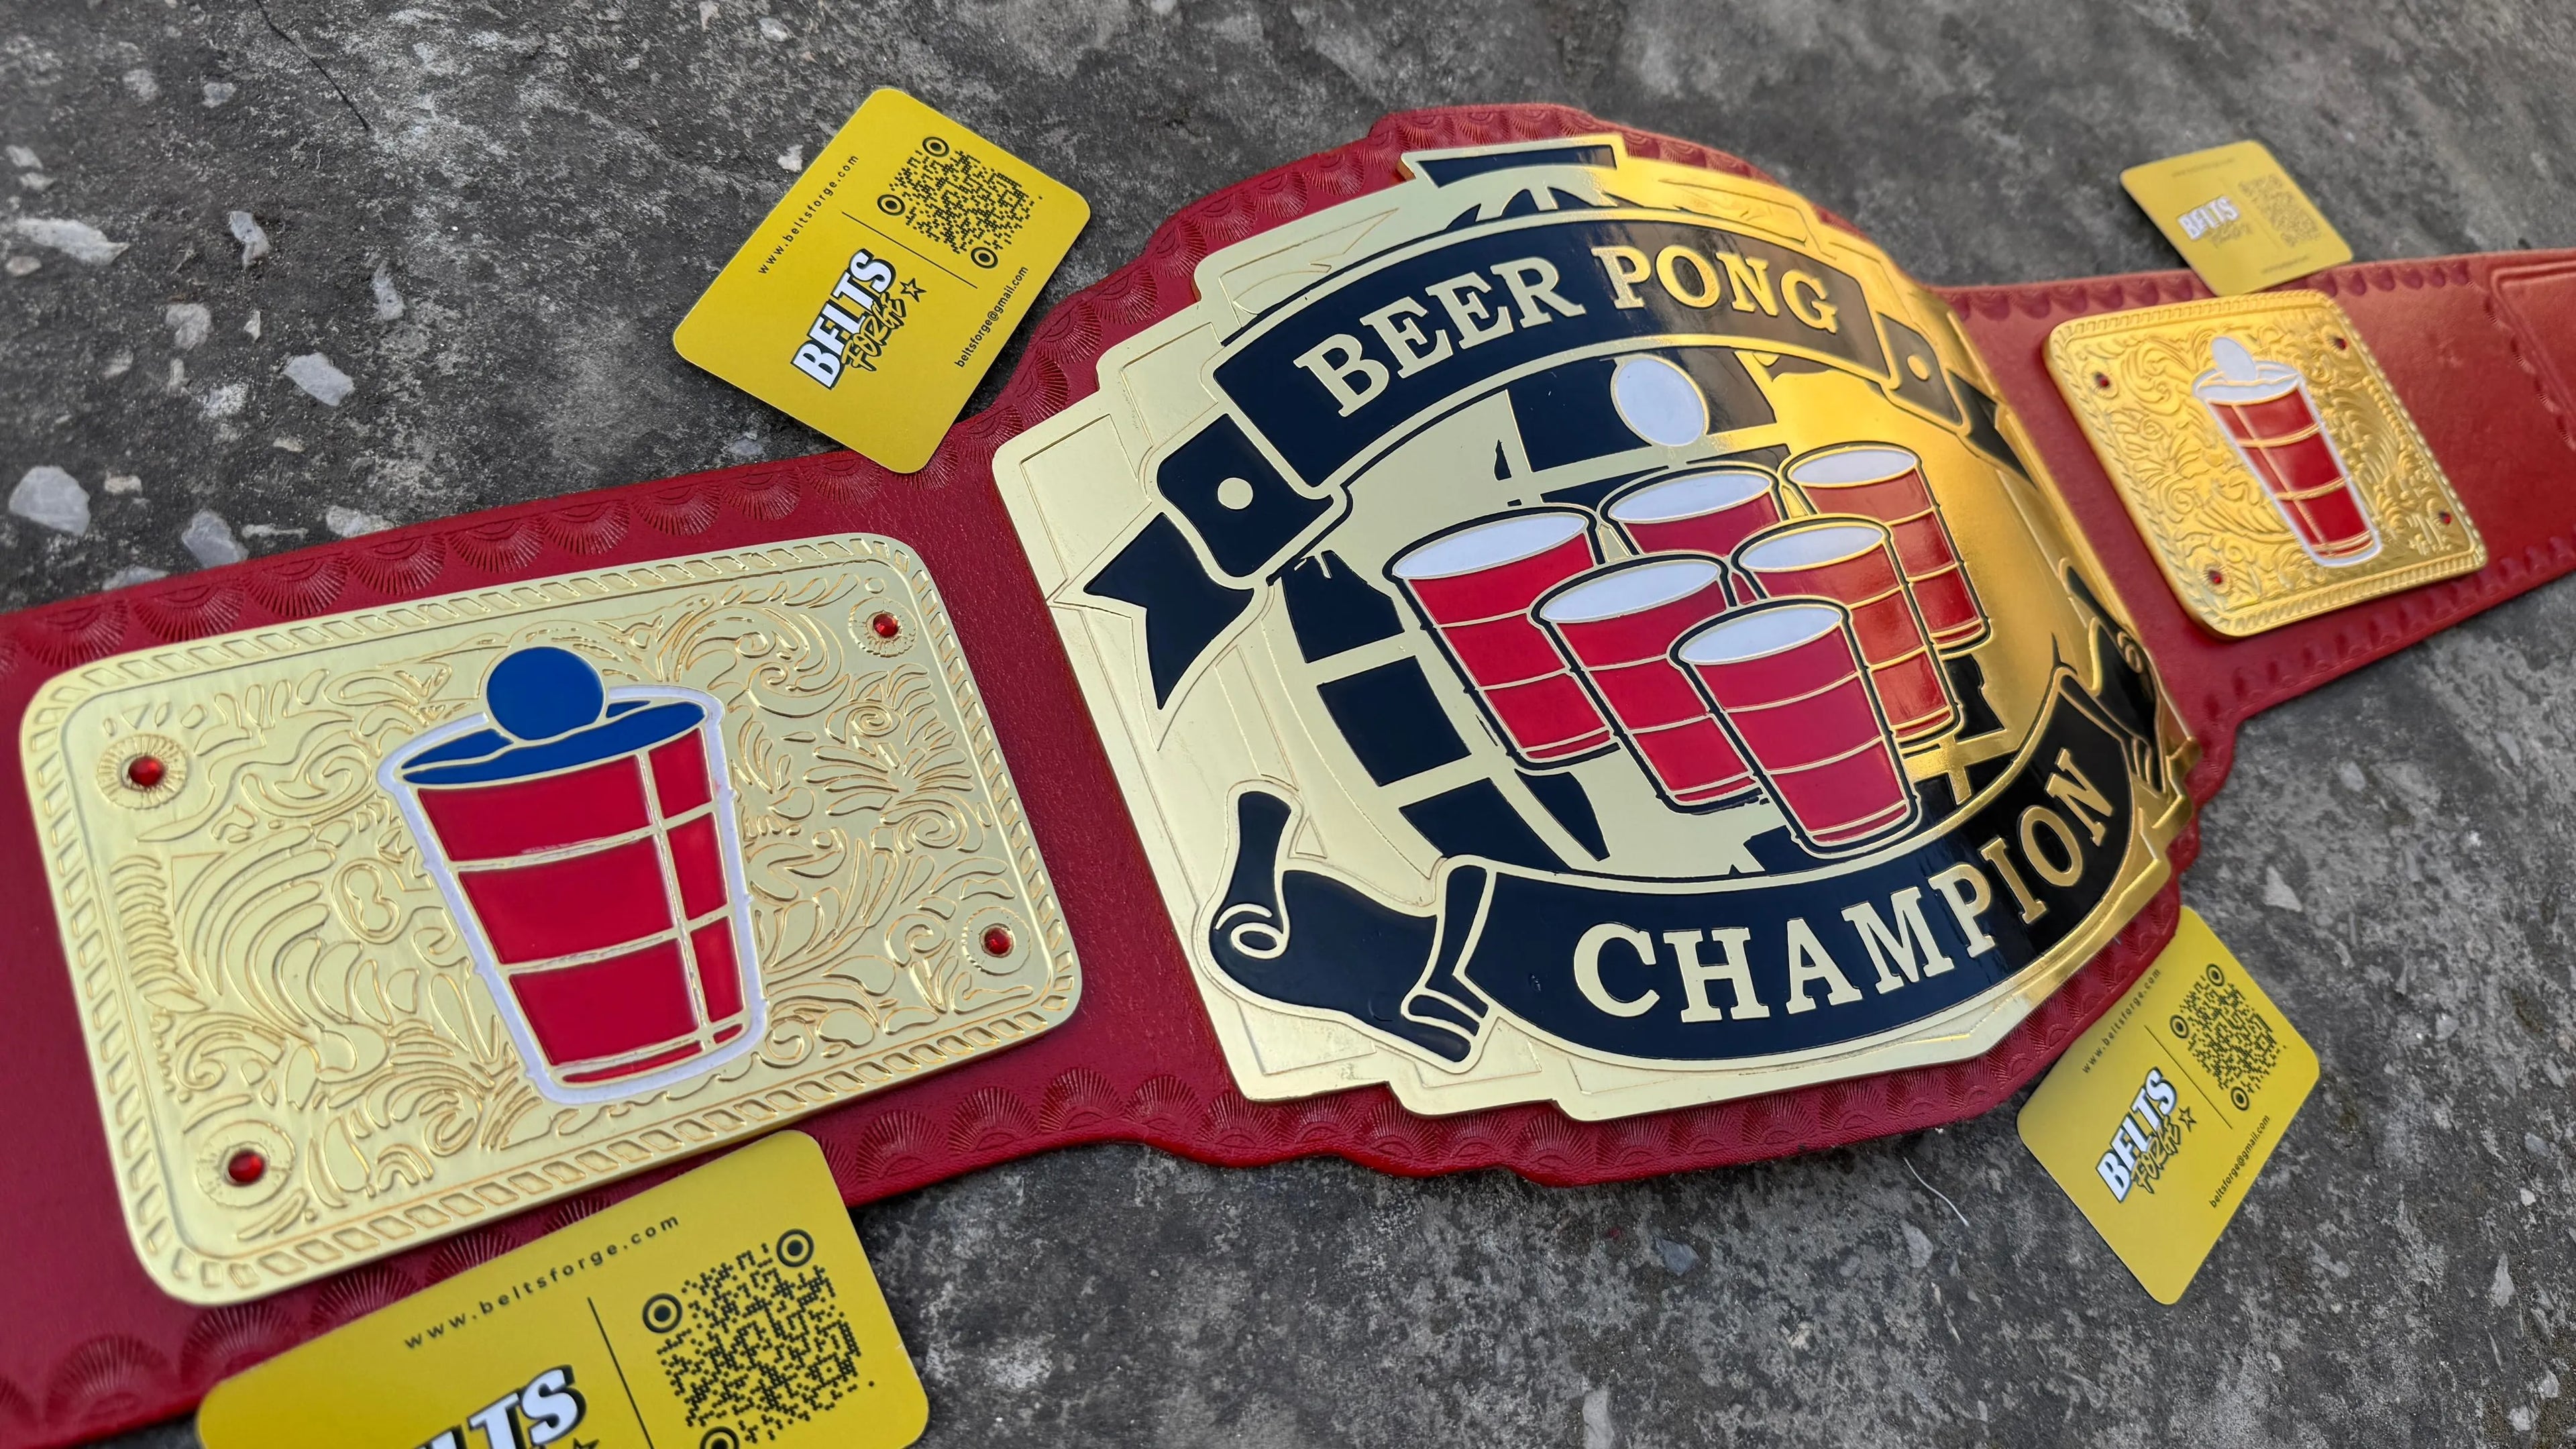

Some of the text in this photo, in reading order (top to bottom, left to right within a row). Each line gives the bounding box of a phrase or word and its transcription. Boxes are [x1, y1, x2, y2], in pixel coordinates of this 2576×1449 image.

[758, 155, 859, 274] www.beltsforge.com
[2176, 195, 2240, 241] BELTS
[790, 248, 896, 390] BELTS
[841, 291, 907, 372] FORGE
[954, 266, 1029, 368] beltsforge@gmail.com
[1293, 245, 1839, 417] BEER PONG
[1573, 747, 2115, 1023] CHAMPION
[2082, 969, 2161, 1073] www.beltsforge.com
[2095, 1066, 2178, 1203] BELTS
[2131, 1115, 2181, 1194] FORGE
[2209, 1115, 2270, 1208] beltsforge@gmail.com
[405, 1215, 679, 1349] www.beltsforge.com
